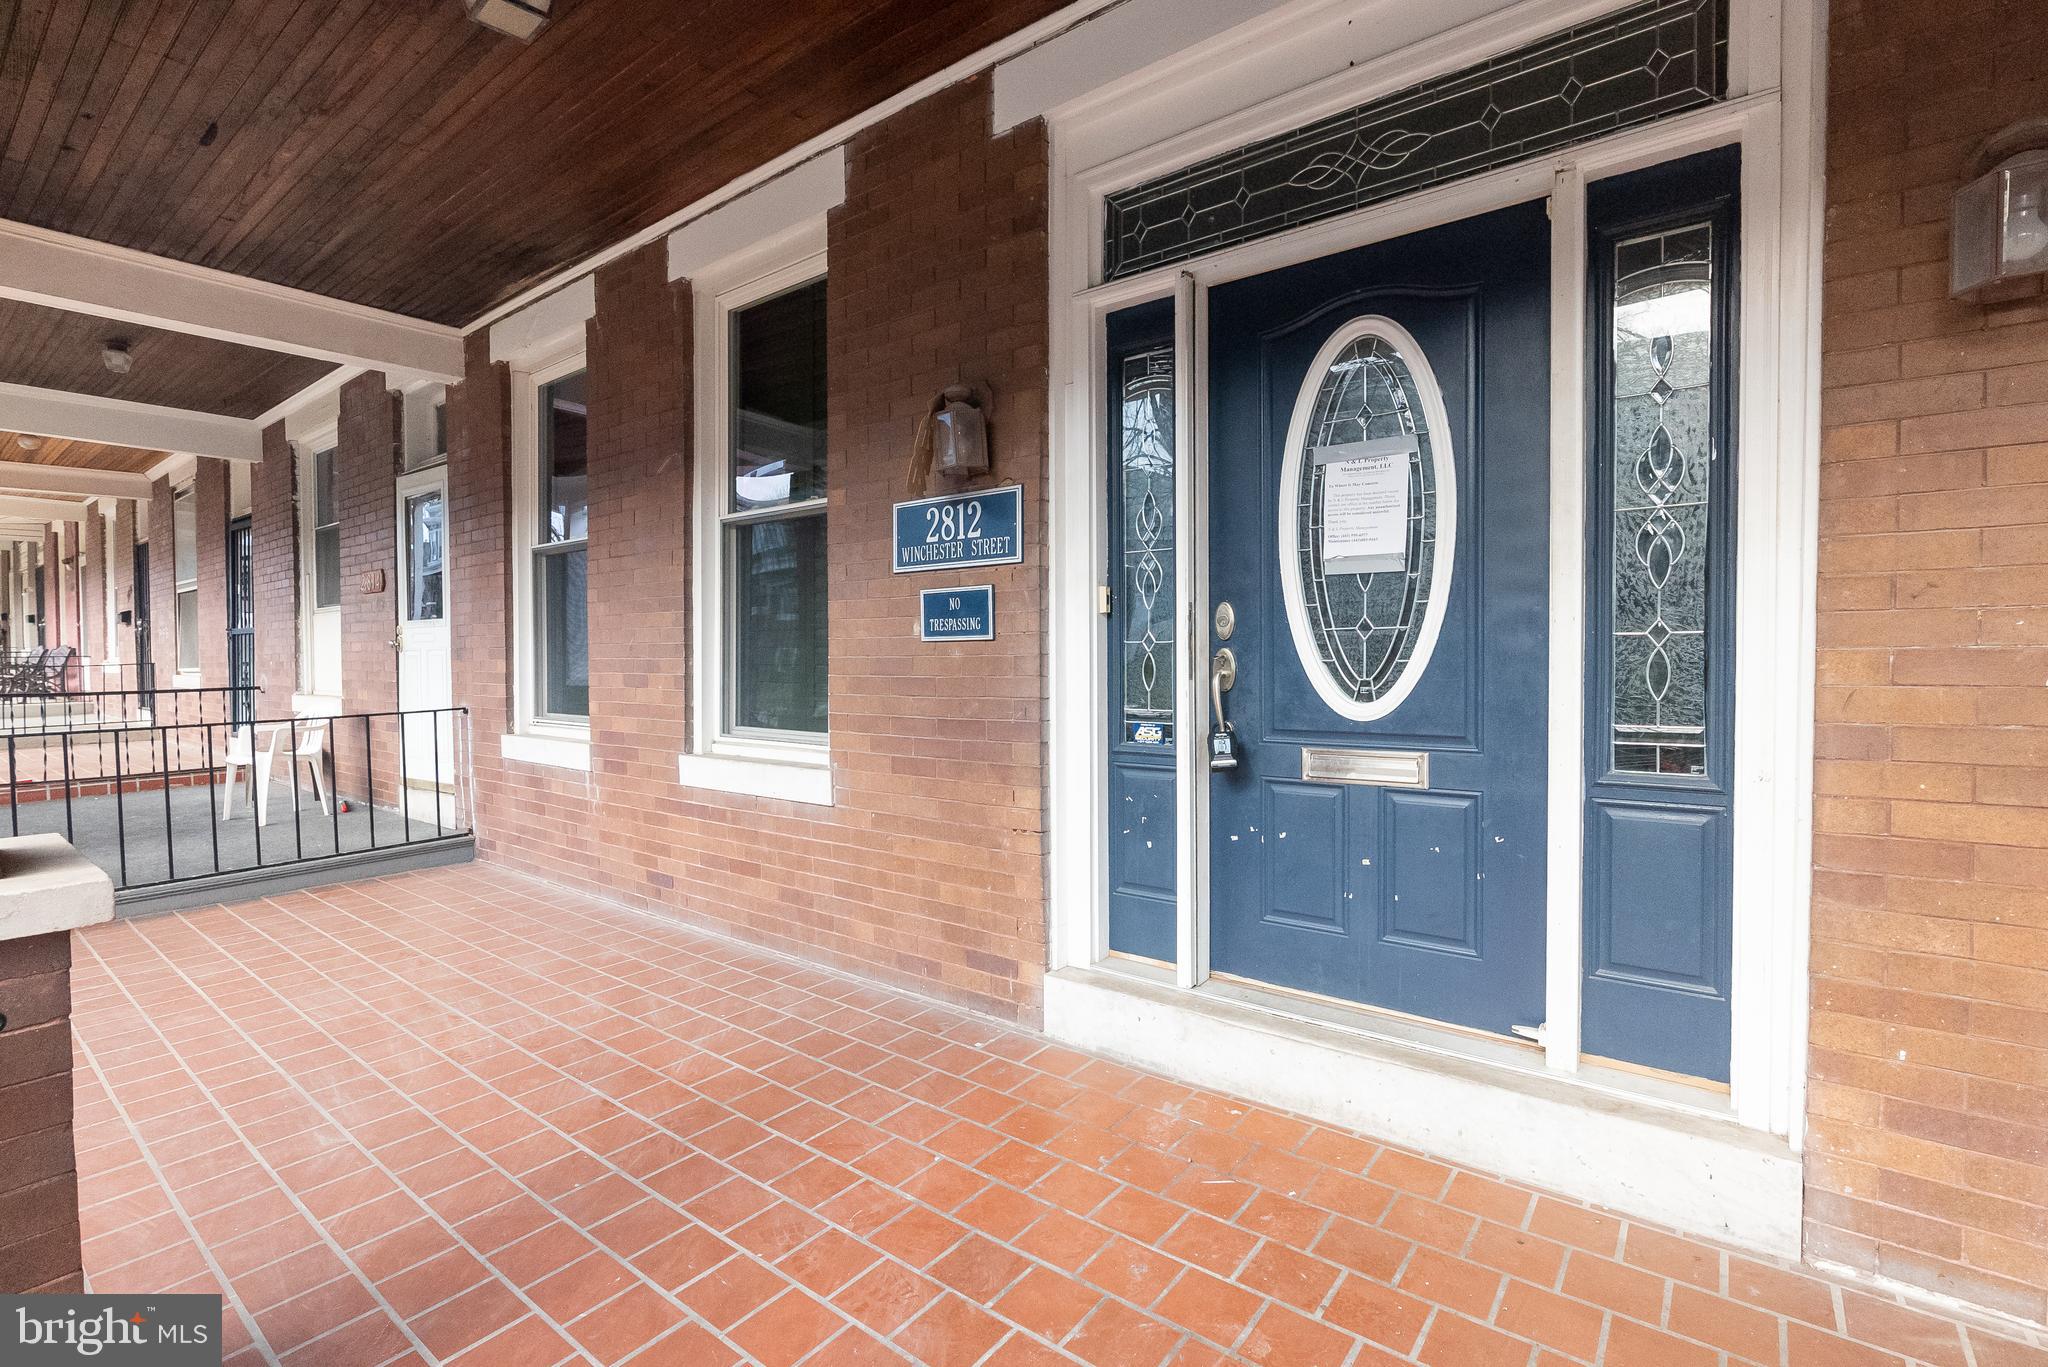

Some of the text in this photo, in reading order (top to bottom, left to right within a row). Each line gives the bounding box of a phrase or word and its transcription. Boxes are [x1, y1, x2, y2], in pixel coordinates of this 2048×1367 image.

[1364, 455, 1390, 464] Property
[926, 501, 982, 543] 2812
[902, 537, 1010, 563] WINCHESTER STREET
[949, 597, 961, 611] NO
[929, 617, 981, 632] TRESPASSING
[1135, 726, 1162, 736] ASG
